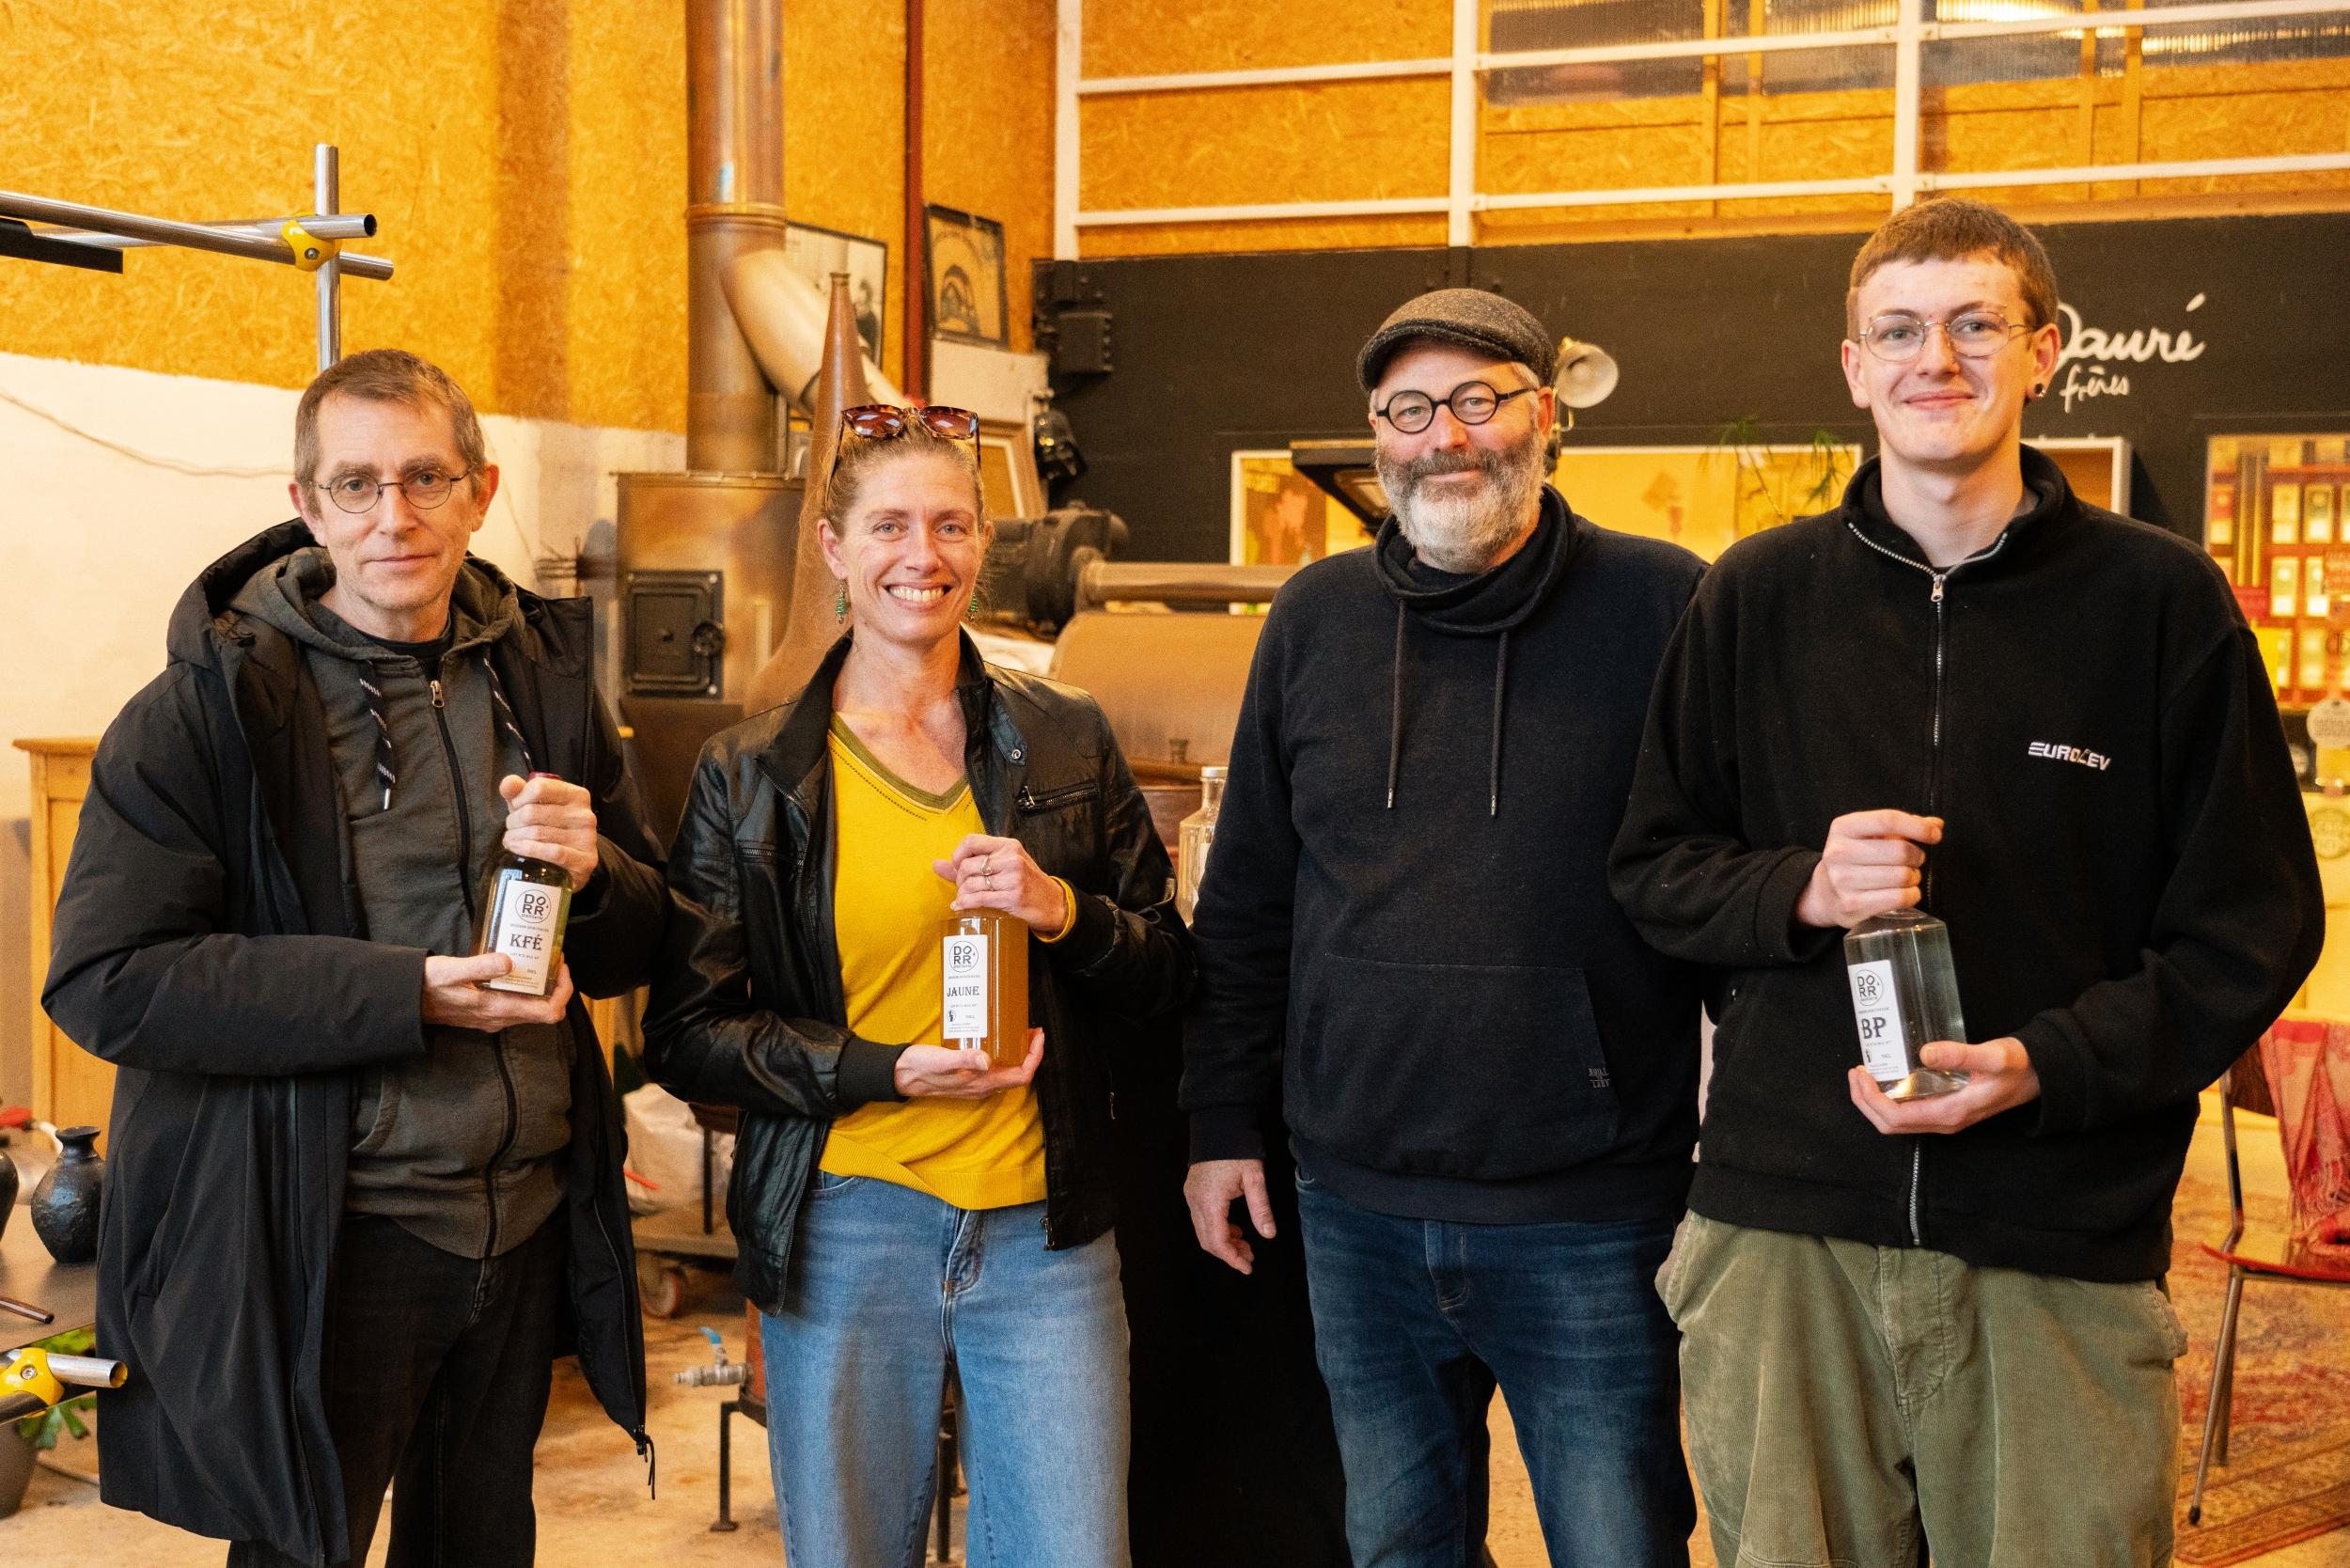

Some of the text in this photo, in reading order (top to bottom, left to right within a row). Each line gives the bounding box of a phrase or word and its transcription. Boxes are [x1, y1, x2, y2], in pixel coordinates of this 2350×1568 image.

[509, 933, 542, 951] KFÉ
[947, 985, 979, 997] JAUNE
[1860, 1016, 1887, 1040] BP
